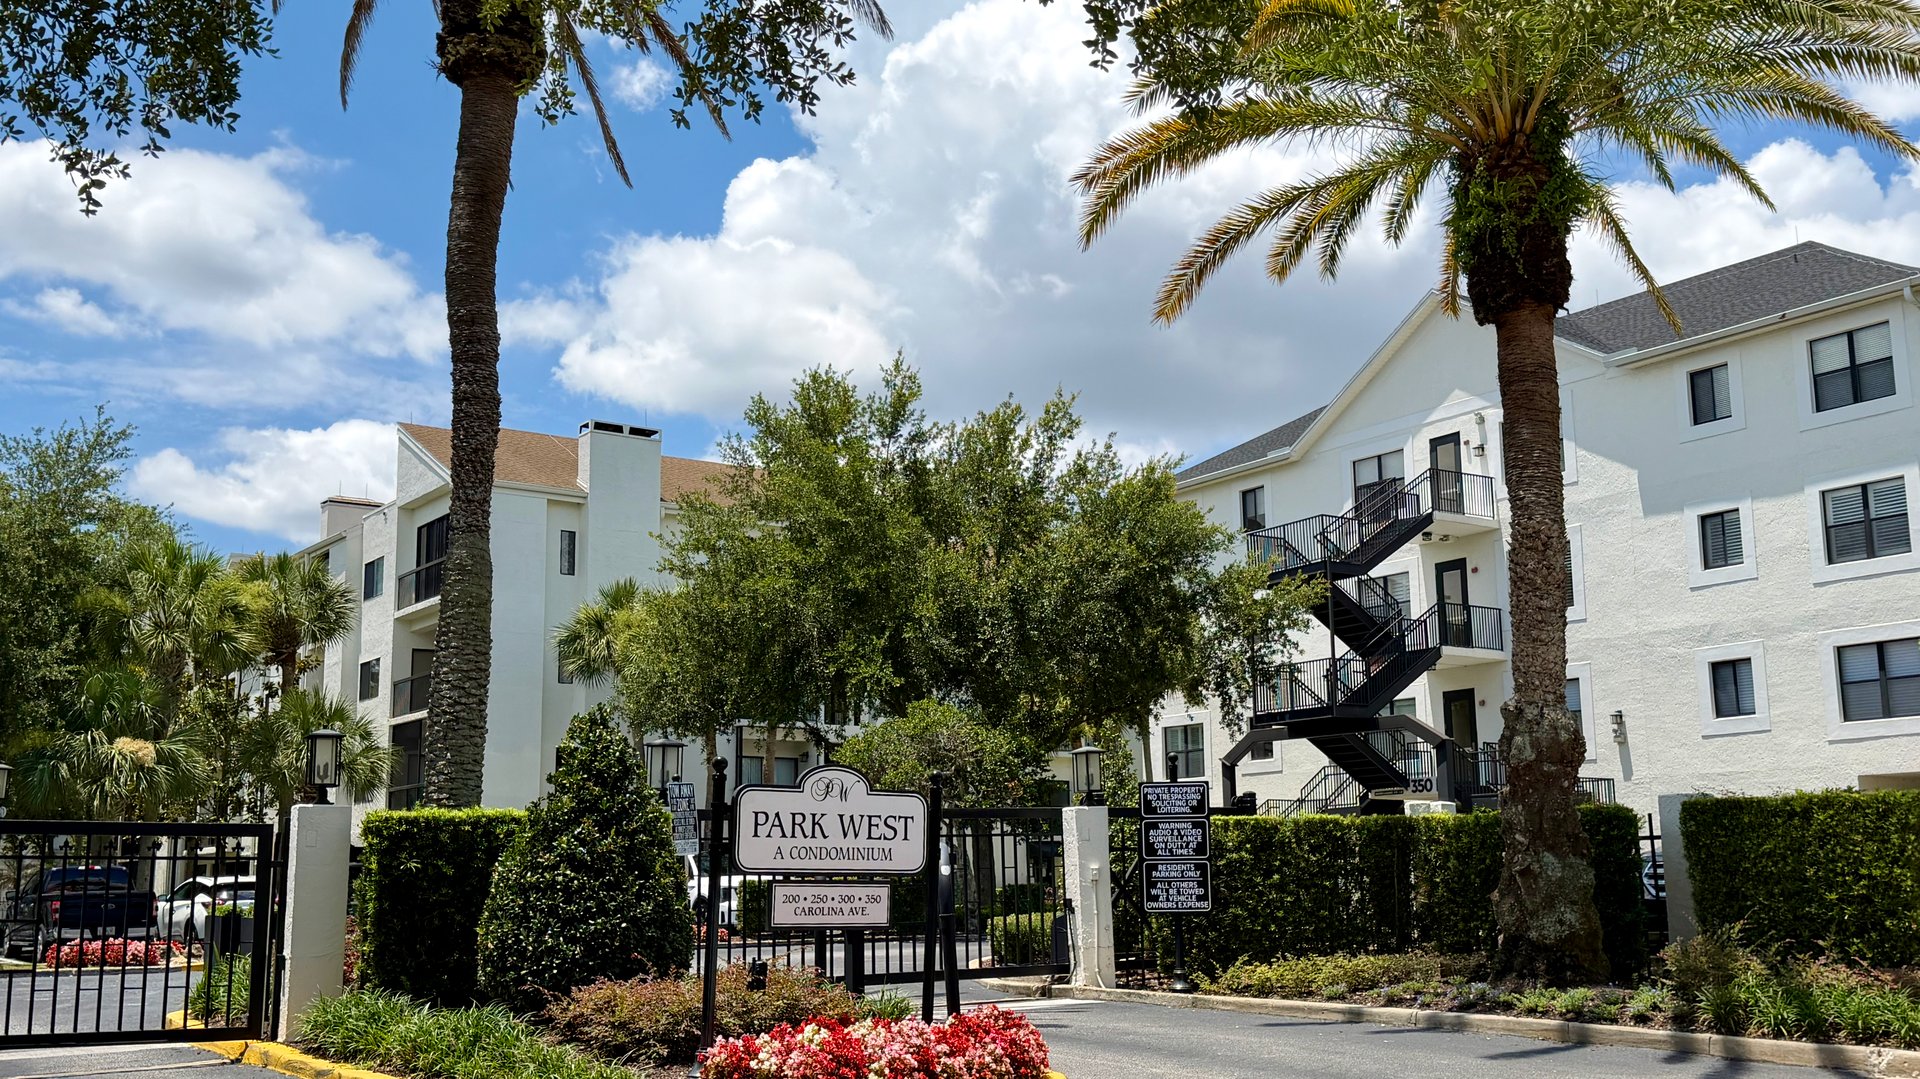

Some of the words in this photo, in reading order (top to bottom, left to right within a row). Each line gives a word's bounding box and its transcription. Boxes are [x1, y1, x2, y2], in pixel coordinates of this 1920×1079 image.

[1410, 778, 1433, 793] 350
[1170, 786, 1204, 794] PROPERTY
[1147, 793, 1157, 801] NO
[752, 810, 829, 840] PARK
[837, 813, 914, 842] WEST
[1180, 828, 1202, 836] VIDEO
[1149, 835, 1202, 843] SURVEILLANCE
[1188, 841, 1198, 849] AT
[773, 845, 784, 860] A
[789, 845, 893, 862] CONDOMINIUM
[1172, 848, 1196, 856] TIMES.
[1158, 863, 1195, 871] RESIDENTS
[1152, 870, 1182, 878] PARKING
[1183, 870, 1201, 878] ONLY
[1170, 881, 1198, 889] OTHERS
[1150, 888, 1167, 896] WILL
[782, 893, 800, 904] 200
[810, 893, 828, 904] 250
[837, 894, 856, 904] 300
[864, 894, 882, 904] 350
[1168, 894, 1197, 902] VEHICLE
[1146, 901, 1177, 909] OWNERS
[793, 906, 845, 917] CAROLINA
[847, 906, 870, 917] AVE.
